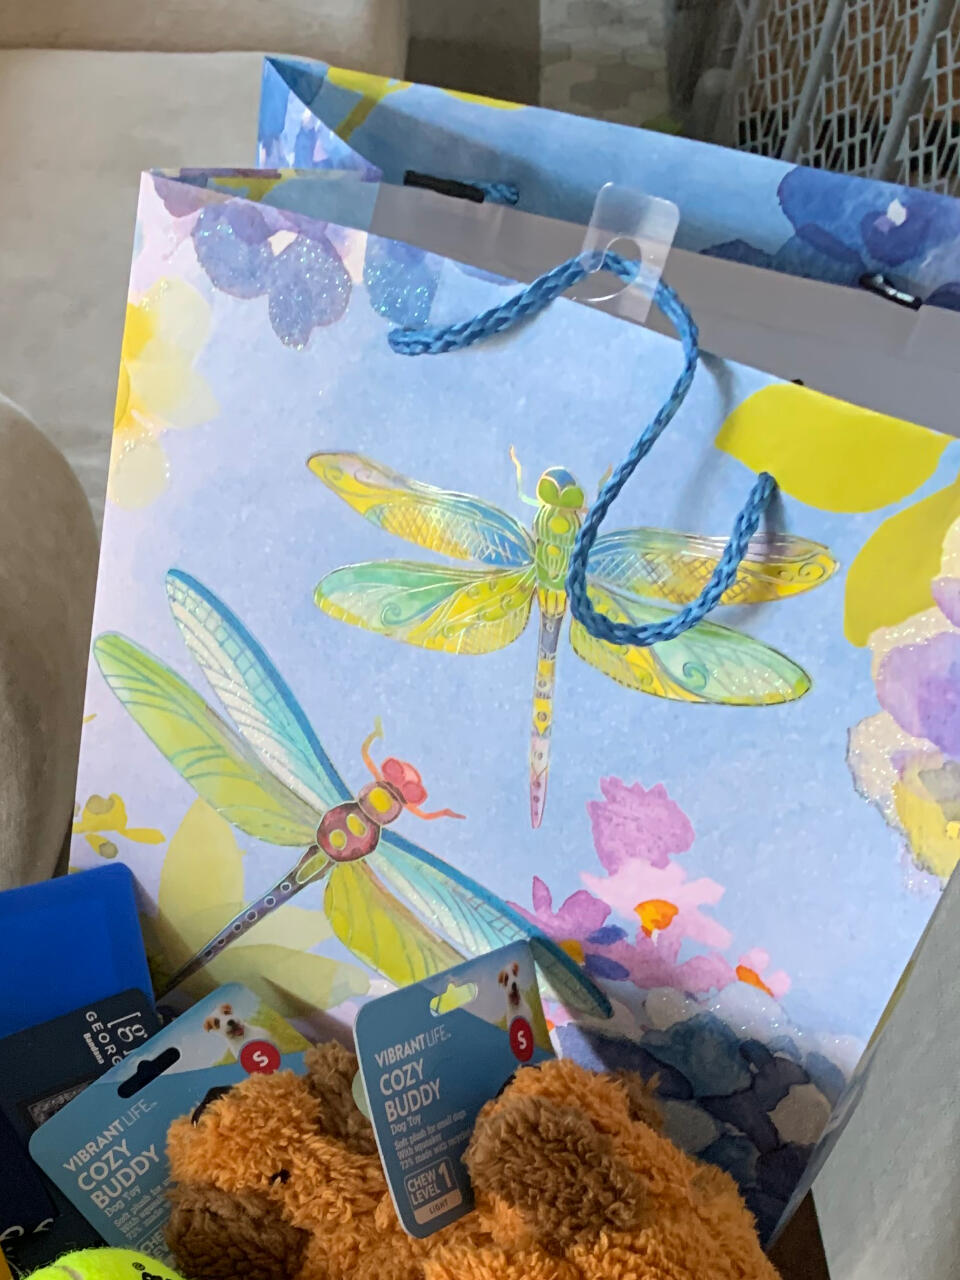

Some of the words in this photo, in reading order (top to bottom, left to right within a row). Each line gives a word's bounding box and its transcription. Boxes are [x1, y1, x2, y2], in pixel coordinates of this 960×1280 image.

[83, 1033, 104, 1064] Bandana
[86, 1011, 122, 1065] GEORG
[375, 1034, 426, 1068] VIBRANT
[518, 1030, 527, 1050] S
[252, 1051, 268, 1067] S
[380, 1059, 424, 1096] COZY
[384, 1078, 440, 1122] BUDDY
[391, 1120, 409, 1136] Dog
[410, 1112, 422, 1130] Toy
[62, 1120, 124, 1172] VIBRANT
[78, 1139, 131, 1191] COZY
[91, 1144, 159, 1209] BUDDY
[436, 1162, 451, 1189] 1
[406, 1171, 437, 1192] CHEW
[409, 1181, 441, 1205] LEVEL
[104, 1202, 125, 1217] Dog
[123, 1185, 141, 1200] Toy
[427, 1198, 450, 1215] LIGHT
